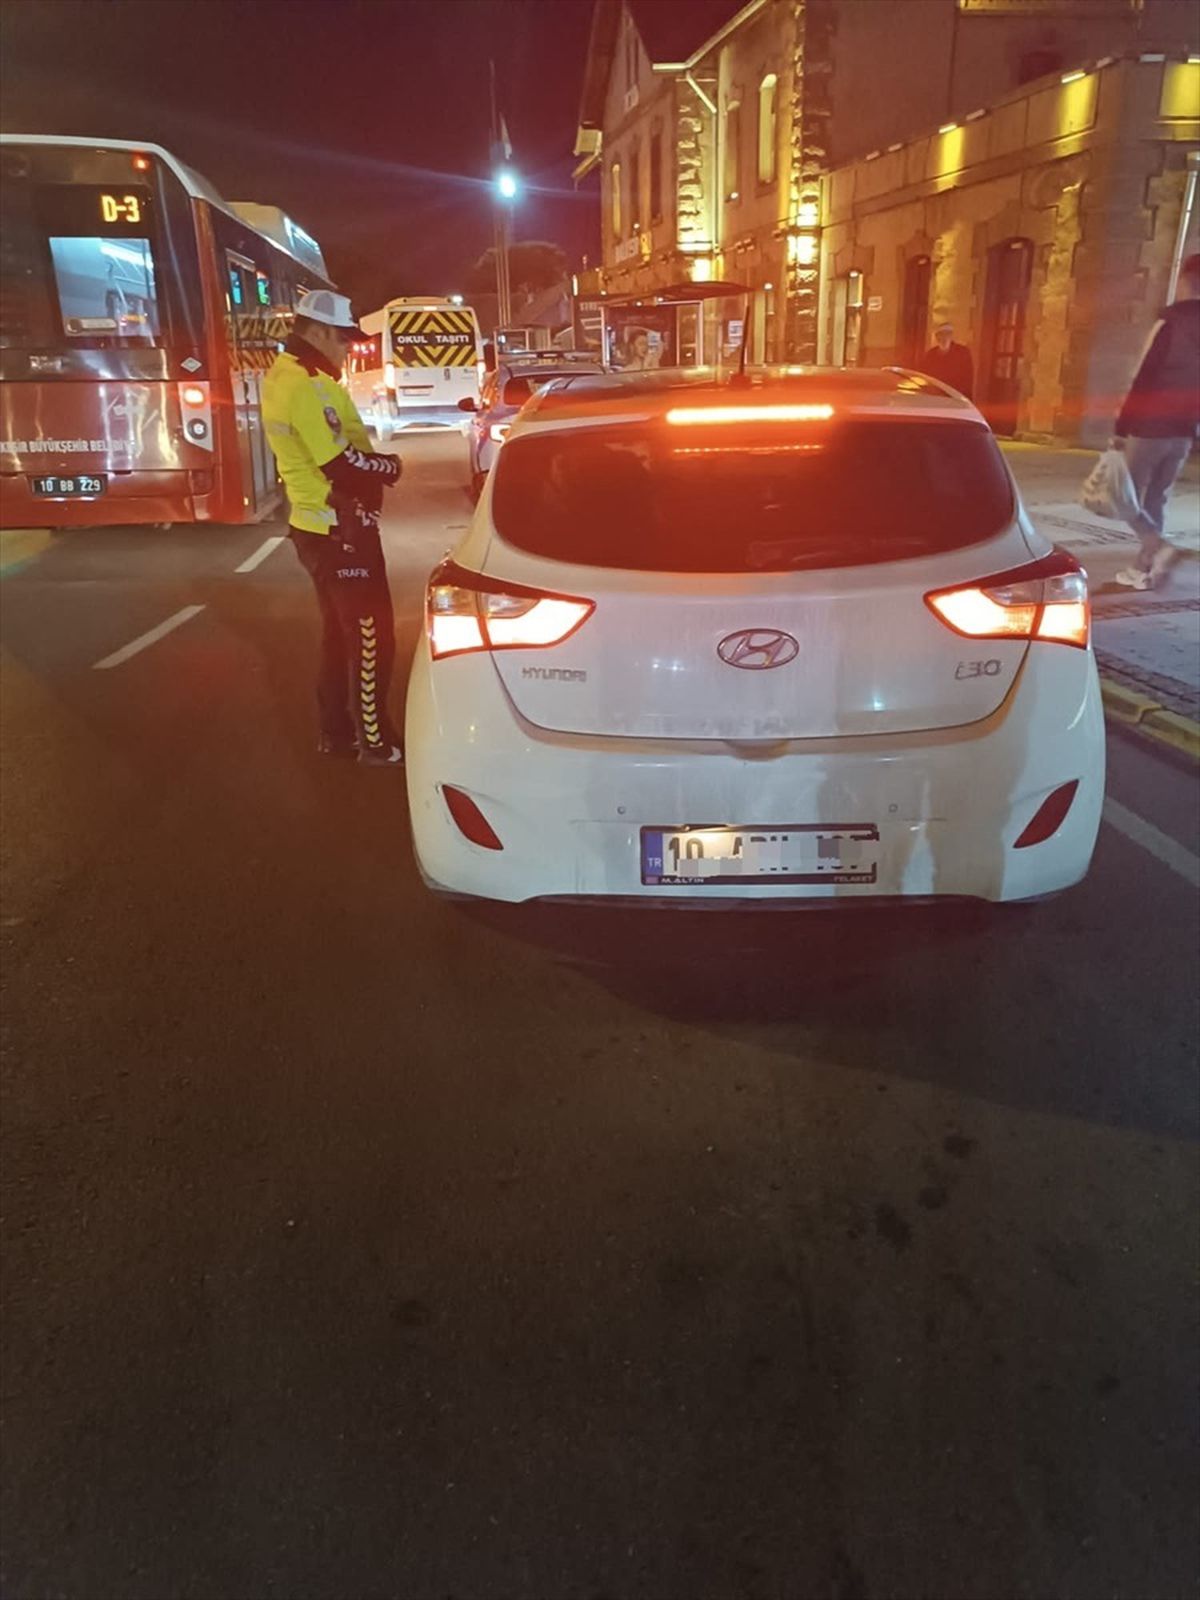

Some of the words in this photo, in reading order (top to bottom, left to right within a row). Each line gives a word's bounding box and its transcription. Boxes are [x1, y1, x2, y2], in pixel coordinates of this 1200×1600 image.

[101, 195, 140, 222] D-3
[397, 335, 428, 344] OKUL
[40, 480, 54, 492] 10
[80, 480, 101, 492] 229
[522, 667, 587, 682] HYUNDAI
[648, 857, 662, 867] TR
